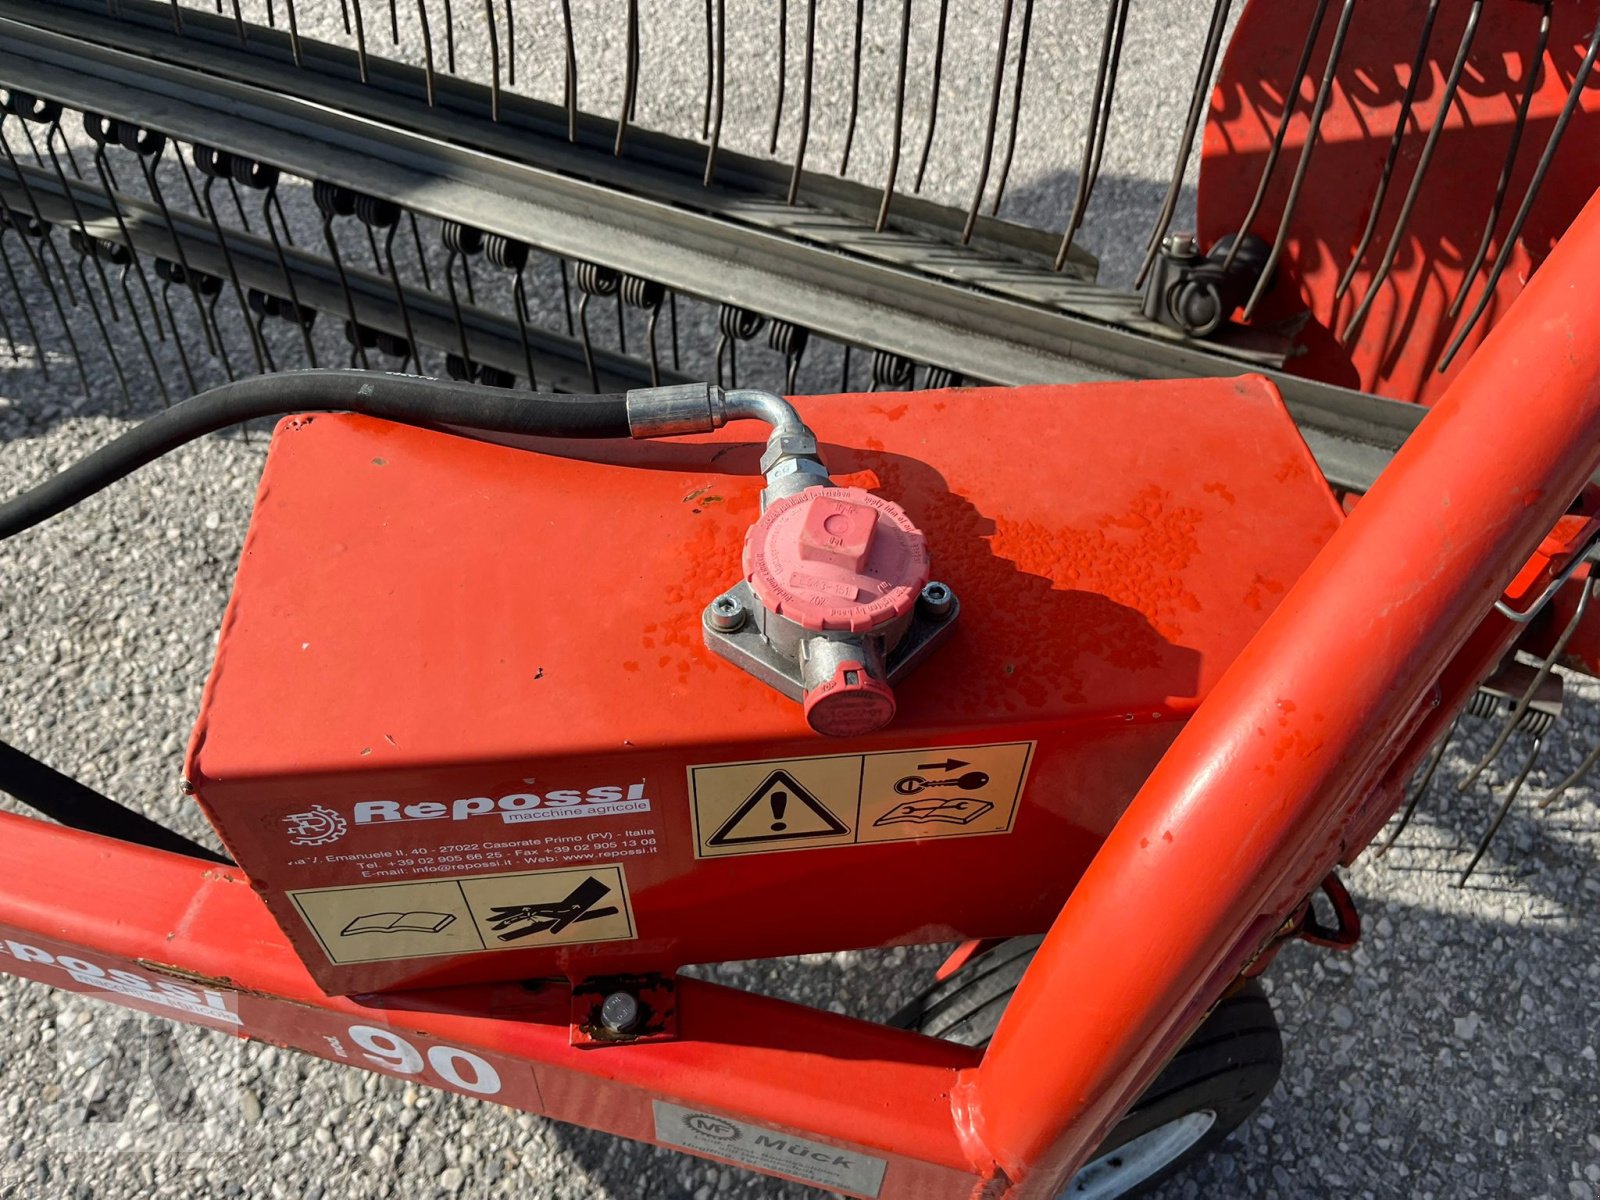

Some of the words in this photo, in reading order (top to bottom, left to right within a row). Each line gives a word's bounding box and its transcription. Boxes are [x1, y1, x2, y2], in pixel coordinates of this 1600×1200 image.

[354, 783, 645, 823] Repossi
[509, 808, 582, 821] macchine
[588, 801, 647, 815] agricole
[326, 850, 392, 863] Emanuele
[412, 847, 427, 855] 40
[440, 844, 479, 854] 27022
[483, 839, 541, 850] Casorate
[545, 834, 582, 845] Primo
[587, 832, 613, 842] (PV)
[625, 828, 655, 838] Italia
[357, 862, 382, 870] Tel.
[388, 859, 414, 868] +39
[418, 857, 433, 865] 02
[437, 855, 463, 863] 905
[467, 852, 482, 861] 66
[487, 851, 502, 859] 25
[515, 849, 539, 857] Fax
[544, 846, 570, 854] +39
[574, 844, 590, 852] 02
[594, 841, 617, 850] 905
[623, 839, 637, 847] 13
[641, 838, 656, 846] 08
[361, 867, 408, 878] E-mail:
[412, 859, 512, 874] info@repossi.it
[524, 855, 559, 865] Web:
[563, 846, 657, 861] www.repossi.it
[0, 940, 226, 1011] possi
[348, 1025, 502, 1095] 90
[754, 1135, 856, 1169] Mück
